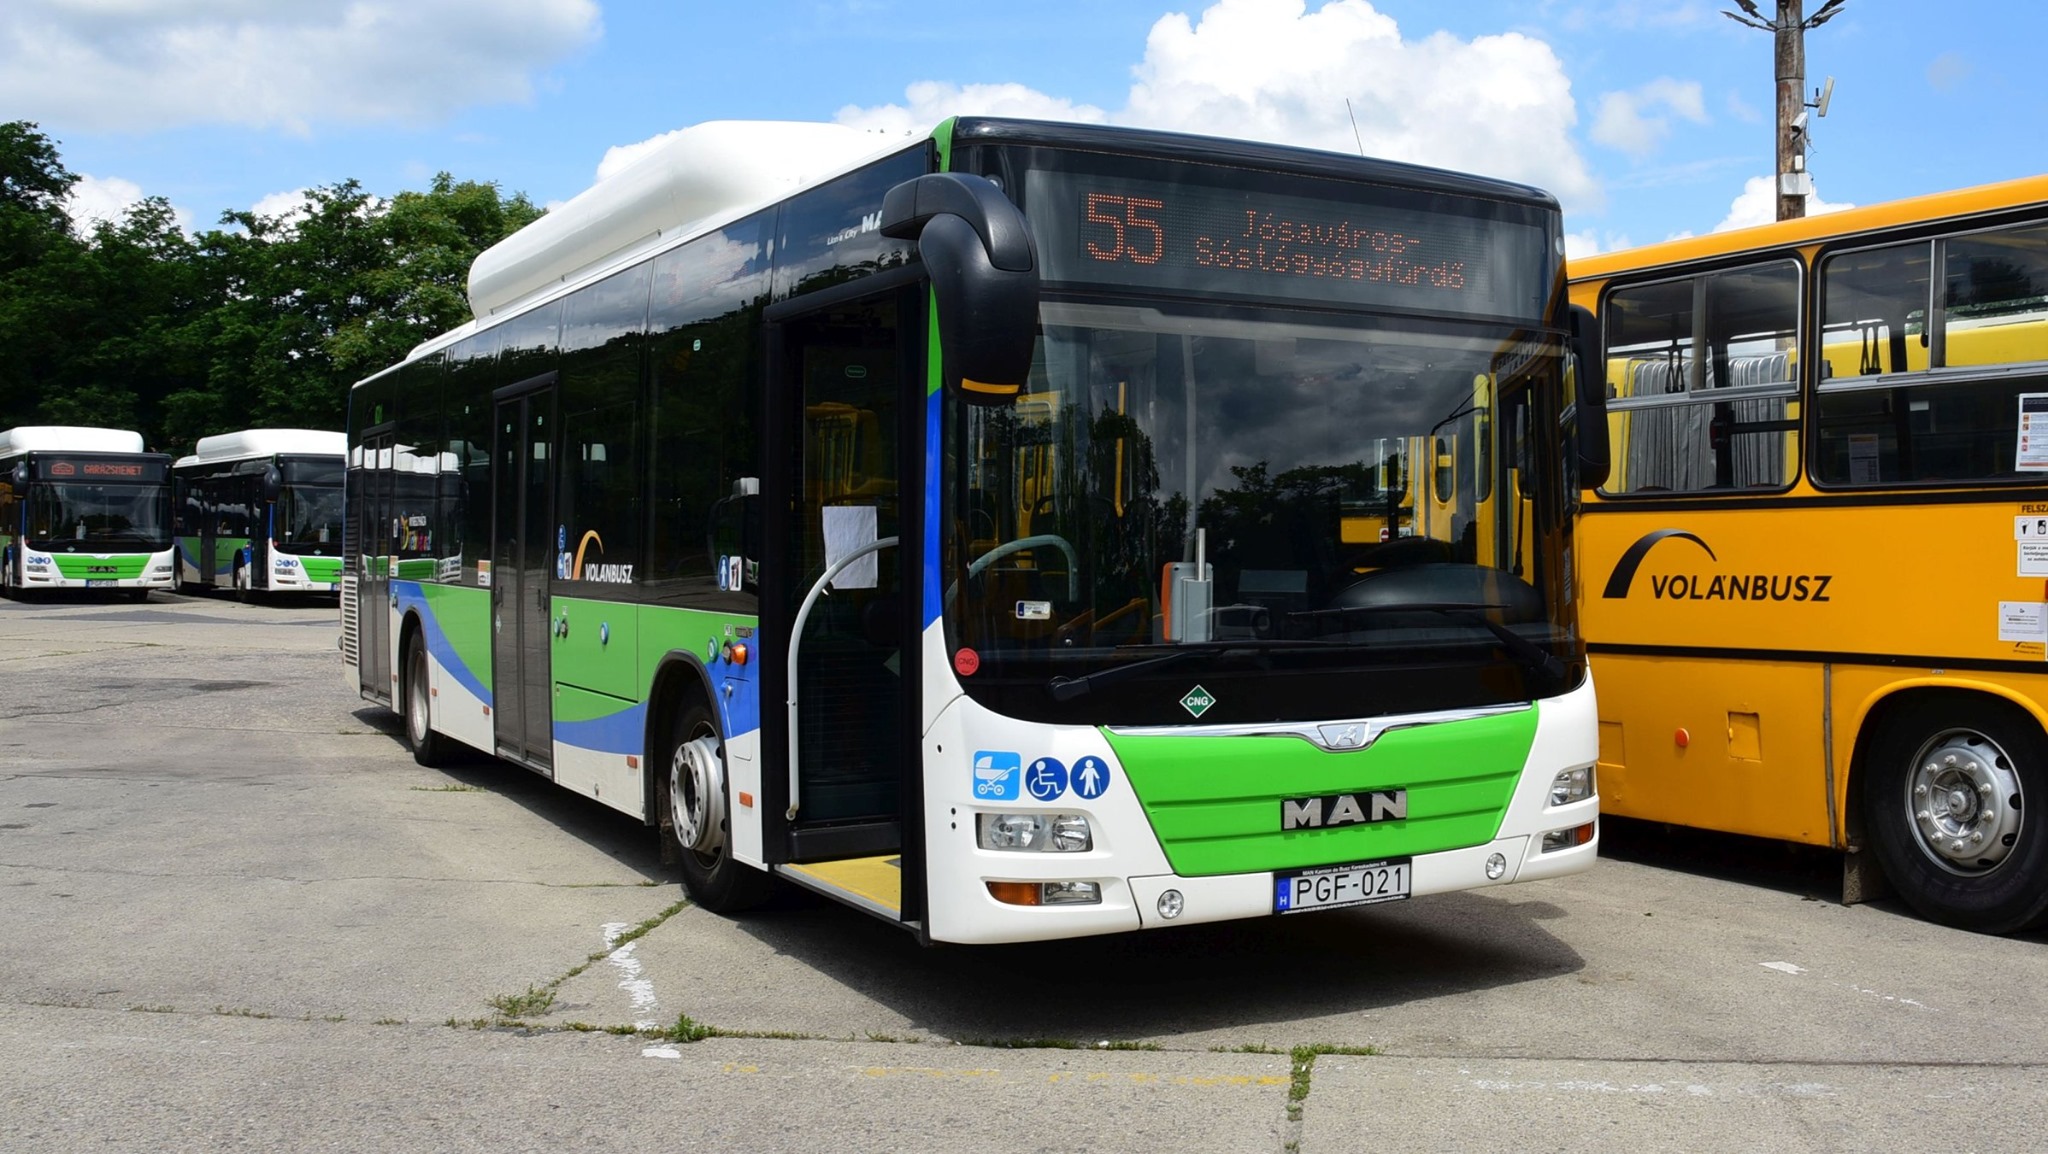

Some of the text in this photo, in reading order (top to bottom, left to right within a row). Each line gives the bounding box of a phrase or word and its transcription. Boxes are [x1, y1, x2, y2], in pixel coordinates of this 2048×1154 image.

[845, 229, 857, 239] City
[1088, 193, 1162, 264] 55
[1242, 210, 1420, 253] Jósaváros-
[1196, 237, 1464, 289] Sóstógyógyfürdő
[1651, 574, 1833, 602] VOLÁNBUSZ
[958, 657, 975, 666] CNG
[1186, 696, 1209, 706] CNG
[1283, 790, 1407, 830] MAN
[1279, 896, 1288, 906] H
[1296, 867, 1402, 905] PGF-021
